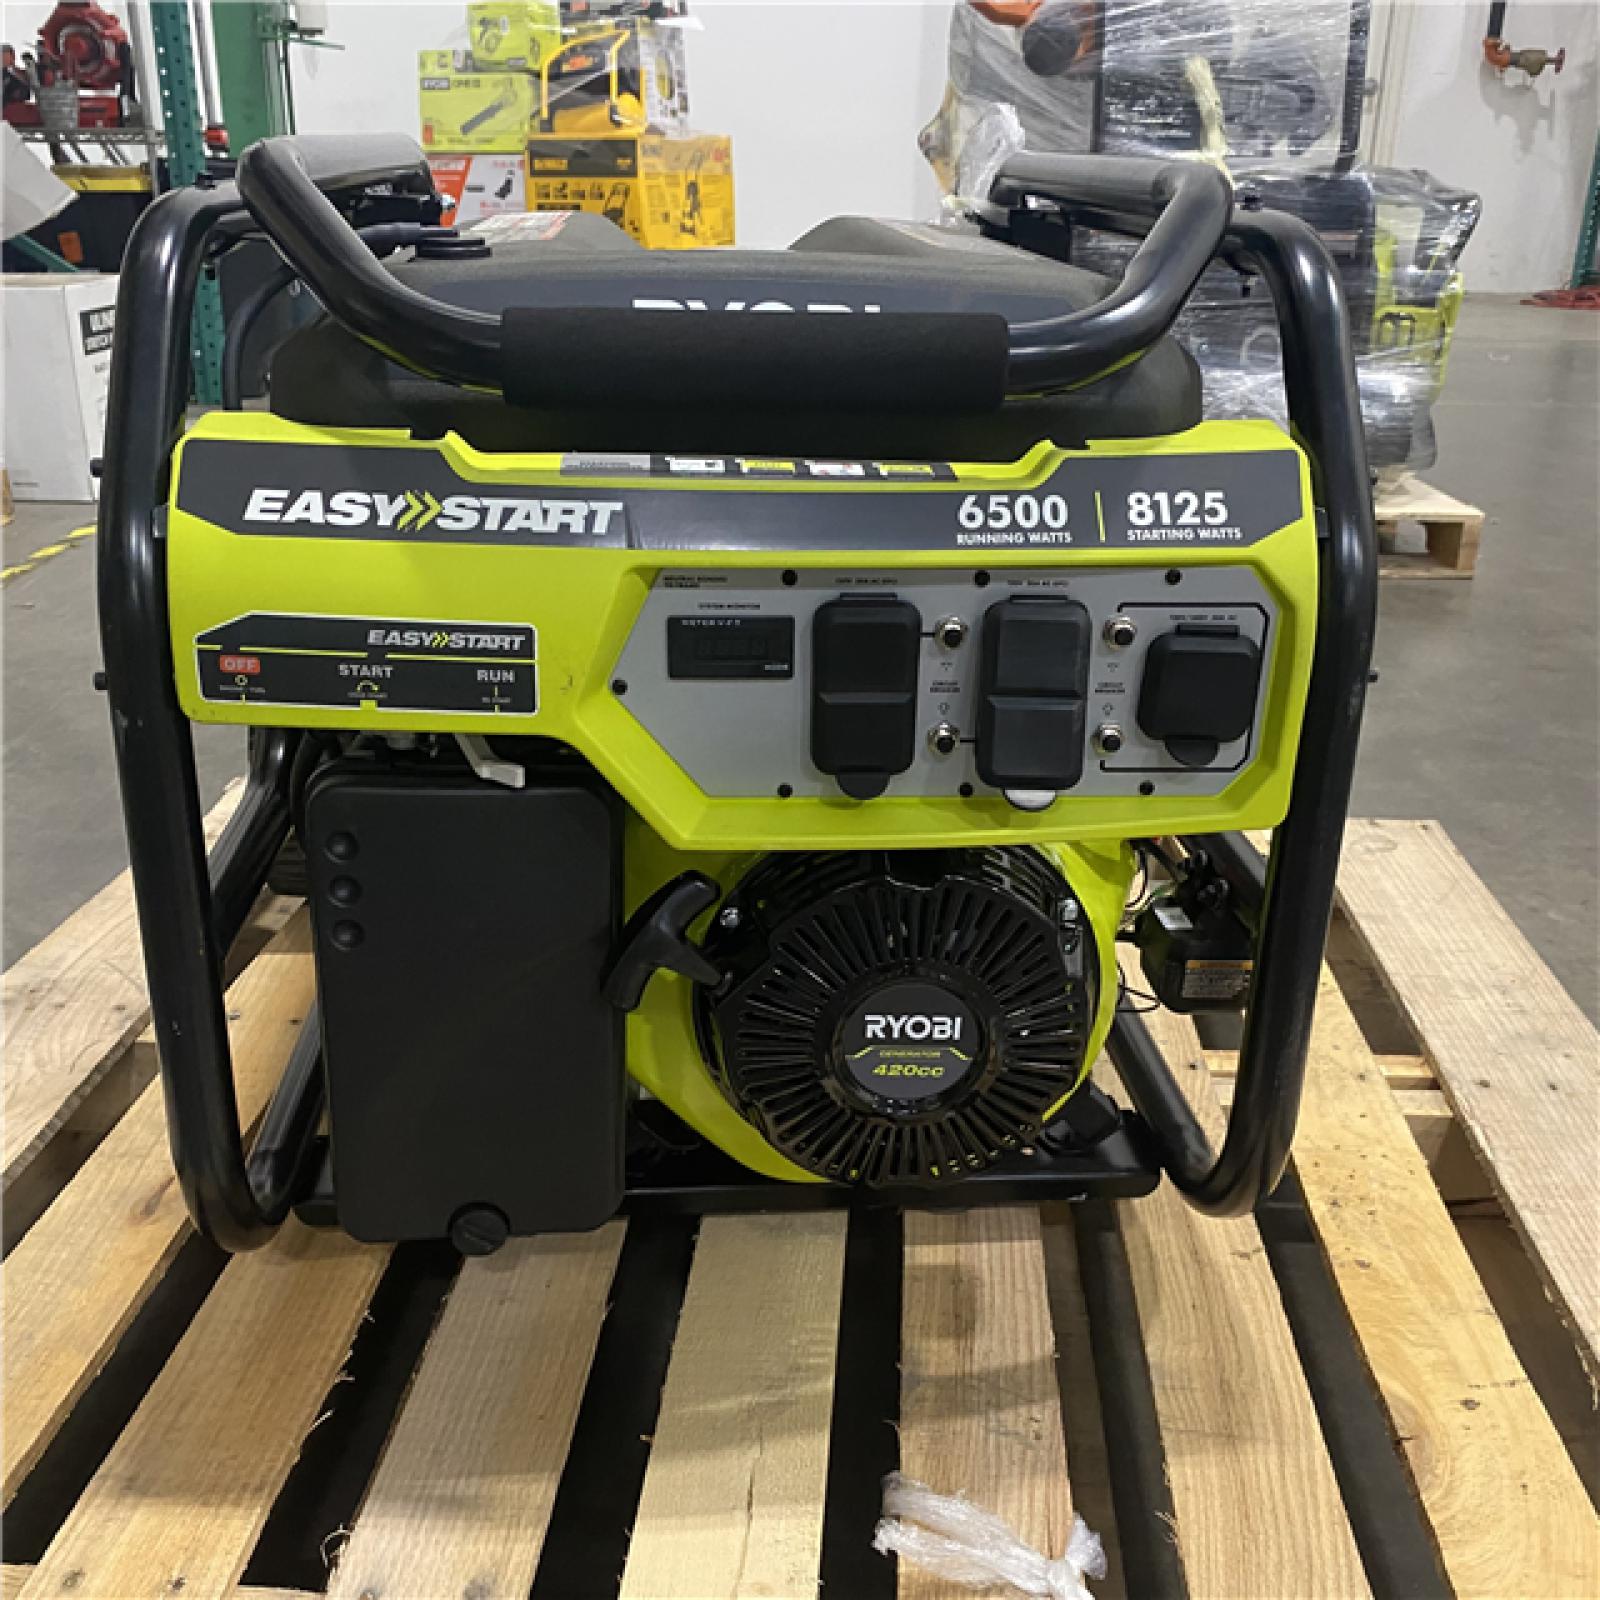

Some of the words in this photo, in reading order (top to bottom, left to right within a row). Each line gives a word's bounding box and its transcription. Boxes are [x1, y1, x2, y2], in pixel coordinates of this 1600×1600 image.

[243, 488, 404, 527] EASY
[436, 496, 624, 535] START
[958, 494, 1069, 529] 6500
[1126, 491, 1228, 526] 8125
[956, 531, 1024, 546] RUNNING
[1029, 531, 1073, 544] WATTS
[1126, 528, 1195, 541] STARTING
[1198, 527, 1243, 541] WATTS
[367, 630, 433, 648] EASY
[448, 632, 526, 650] START
[223, 656, 258, 671] OFF
[338, 664, 393, 678] START
[476, 669, 515, 683] RUN
[864, 1014, 963, 1040] RYOBI
[871, 1064, 945, 1078] 420cc
